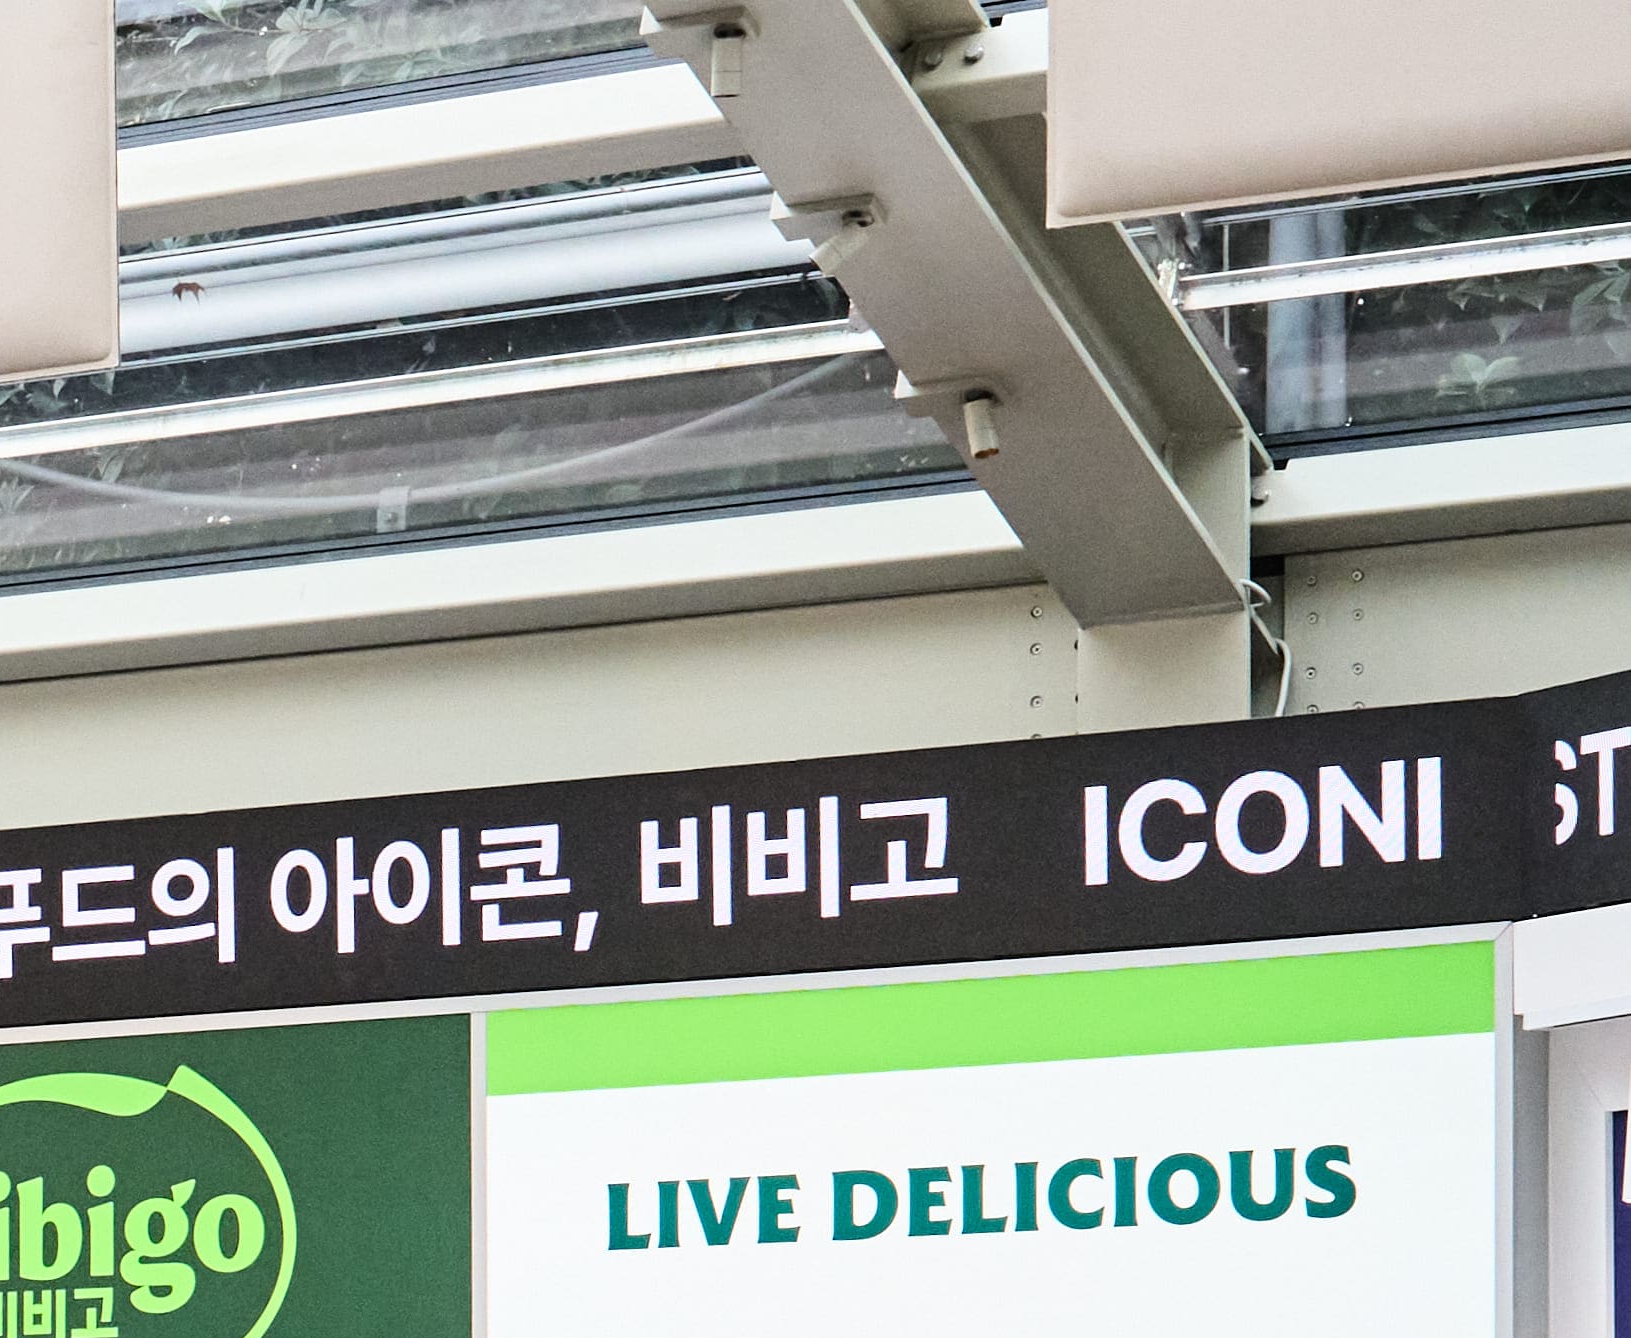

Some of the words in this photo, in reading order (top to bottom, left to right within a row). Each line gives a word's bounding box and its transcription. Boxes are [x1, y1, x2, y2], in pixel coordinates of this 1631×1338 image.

[270, 823, 599, 953] 아이콘,
[640, 796, 959, 926] 비비고
[1083, 757, 1442, 886] ICONI
[608, 1173, 801, 1251] LIVE
[832, 1143, 1357, 1243] DELICIOUS
